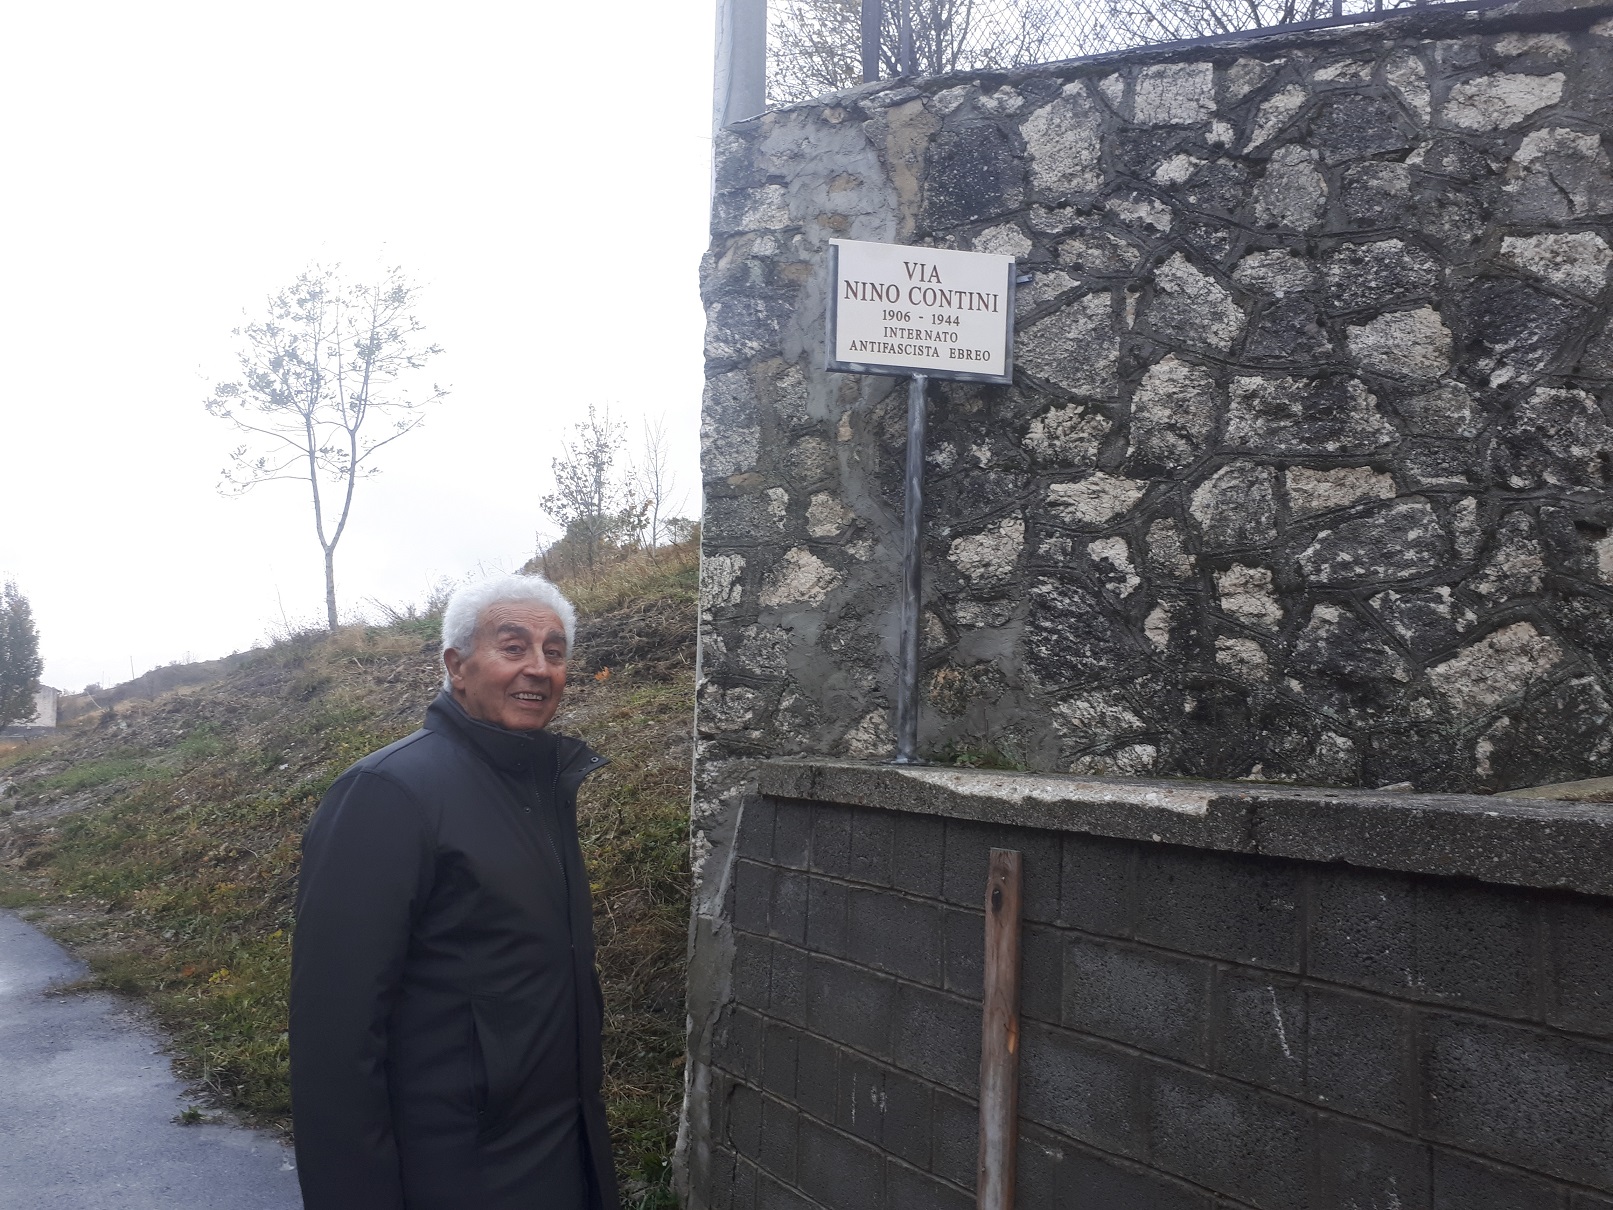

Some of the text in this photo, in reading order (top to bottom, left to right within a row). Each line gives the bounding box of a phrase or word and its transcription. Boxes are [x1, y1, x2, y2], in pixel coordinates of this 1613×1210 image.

[903, 261, 942, 284] VIA
[844, 280, 999, 313] NINO CONTINI
[882, 309, 911, 323] 1906
[931, 313, 961, 327] 1944
[883, 326, 958, 343] INTERNATO
[849, 339, 991, 361] ANTIFASCISTA EBREO
